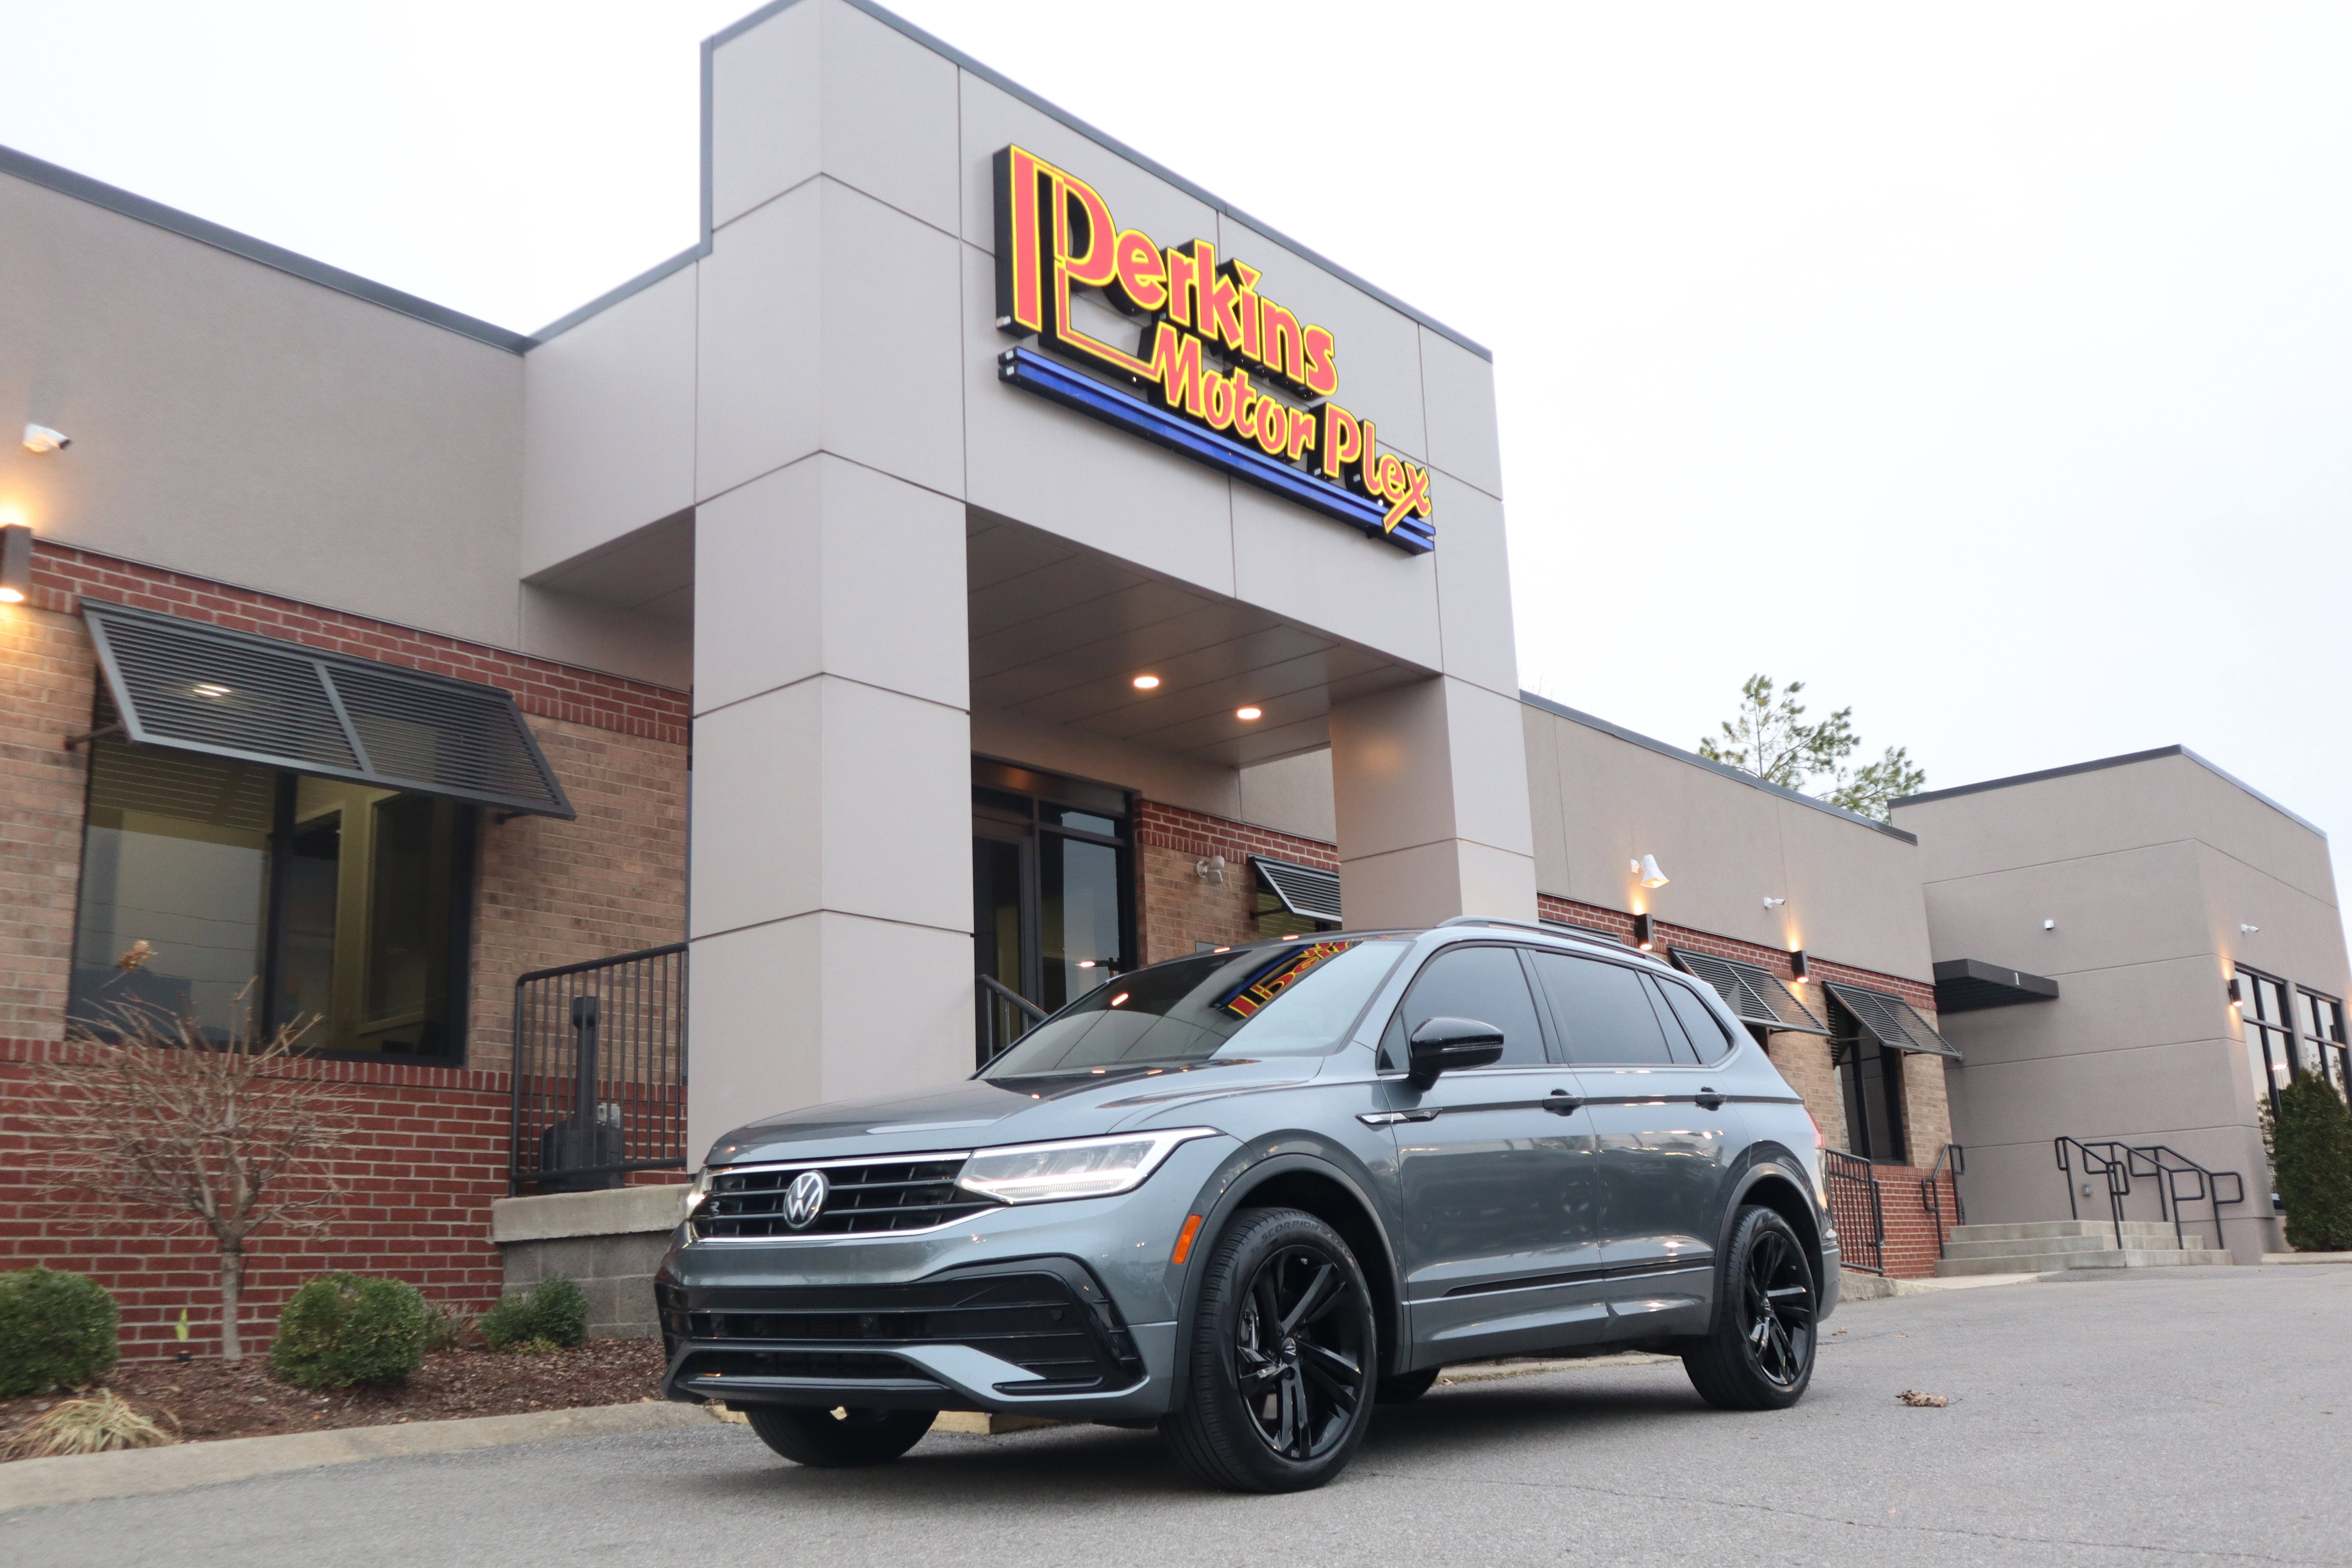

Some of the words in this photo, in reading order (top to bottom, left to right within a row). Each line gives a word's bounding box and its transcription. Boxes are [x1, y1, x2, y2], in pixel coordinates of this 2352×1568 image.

[1009, 143, 1339, 396] Perkins
[1154, 321, 1316, 460] Motor
[1323, 401, 1432, 533] Plex
[1261, 1221, 1320, 1243] SCORPION
